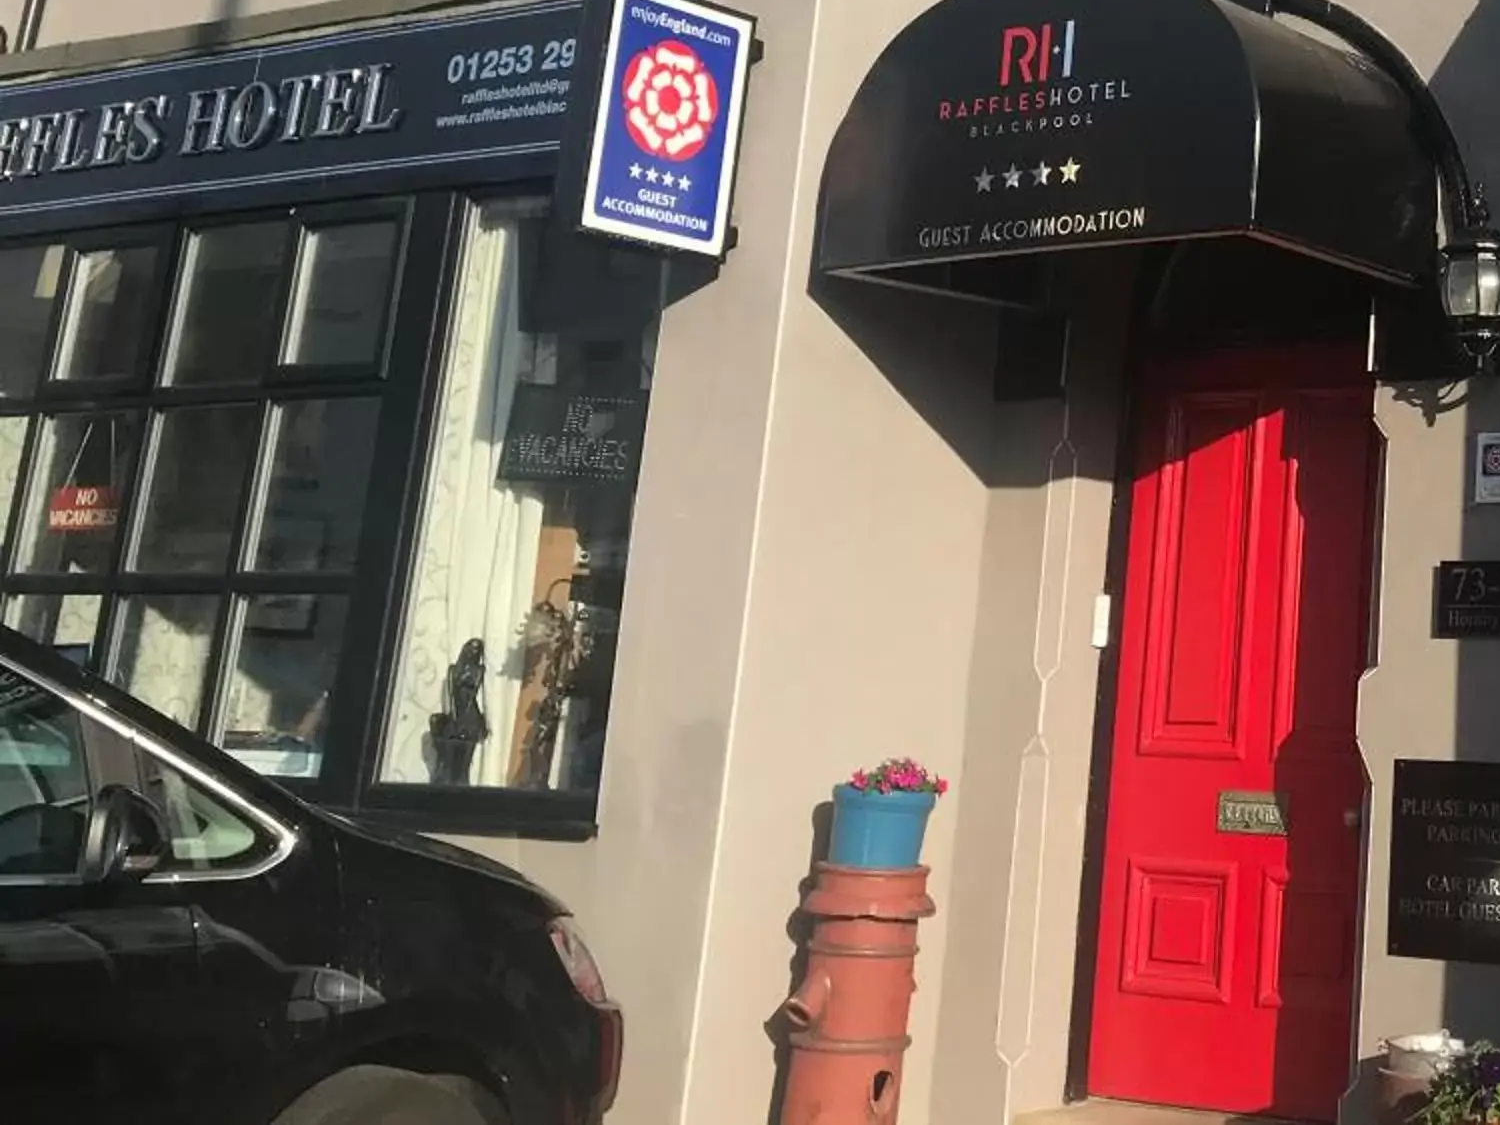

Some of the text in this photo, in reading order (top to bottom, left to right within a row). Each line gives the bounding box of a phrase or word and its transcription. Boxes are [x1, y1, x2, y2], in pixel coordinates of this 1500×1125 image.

[630, 4, 732, 47] enjoyEngland.com
[447, 38, 577, 84] 01253 29
[177, 62, 401, 157] HOTEL
[969, 112, 1094, 138] BLACKPOOL
[637, 188, 678, 208] GUEST
[601, 195, 709, 232] ACCOMMODATION
[918, 206, 1146, 248] GUEST ACCOMMODATION
[75, 487, 99, 506] NO
[1400, 797, 1466, 817] PLEASE
[1426, 874, 1463, 893] CAR
[1399, 899, 1456, 918] HOTEL
